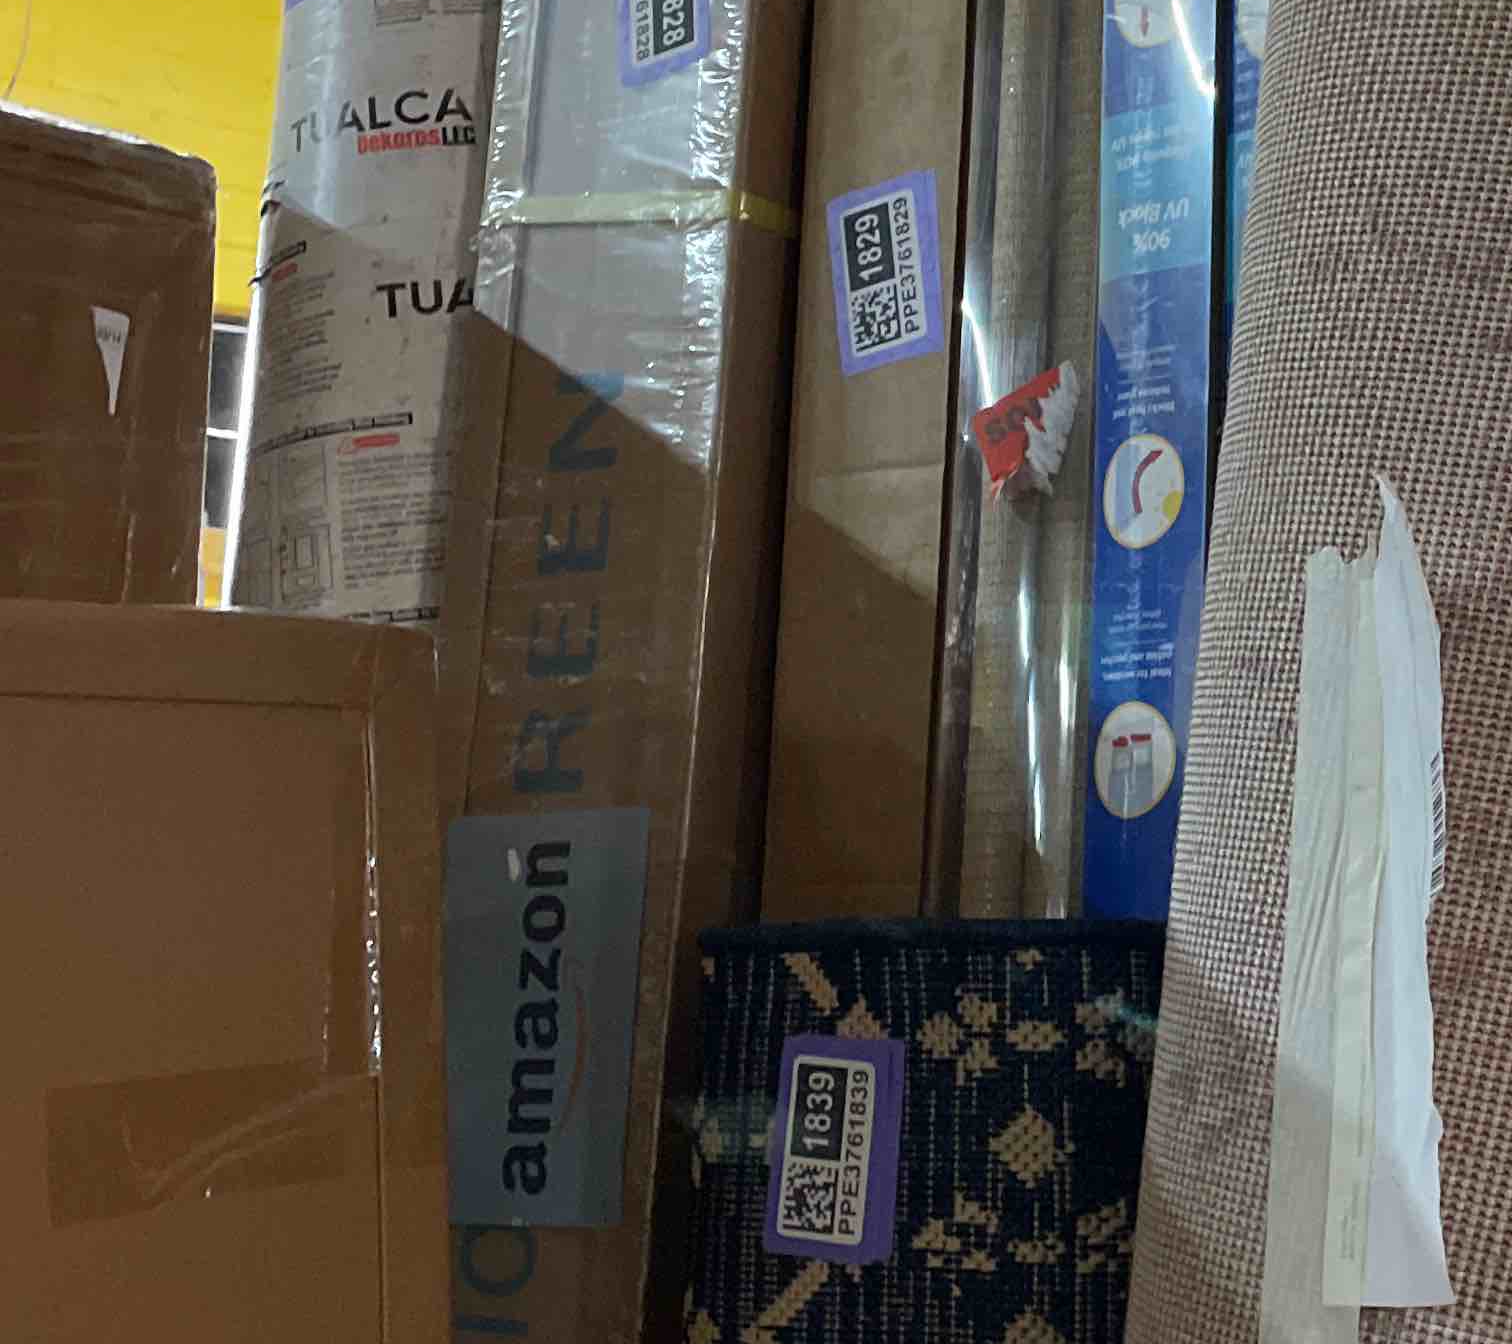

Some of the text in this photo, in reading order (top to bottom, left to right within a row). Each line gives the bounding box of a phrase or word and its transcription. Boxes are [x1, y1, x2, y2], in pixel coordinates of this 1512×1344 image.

[291, 87, 473, 152] TUALCA
[375, 276, 473, 321] TUA
[853, 213, 885, 282] 1829
[892, 196, 921, 334] PPE3761829
[511, 370, 624, 794] REEN
[501, 839, 572, 1197] amazon
[801, 1070, 836, 1152] 1839
[837, 1069, 870, 1236] PPE3761839
